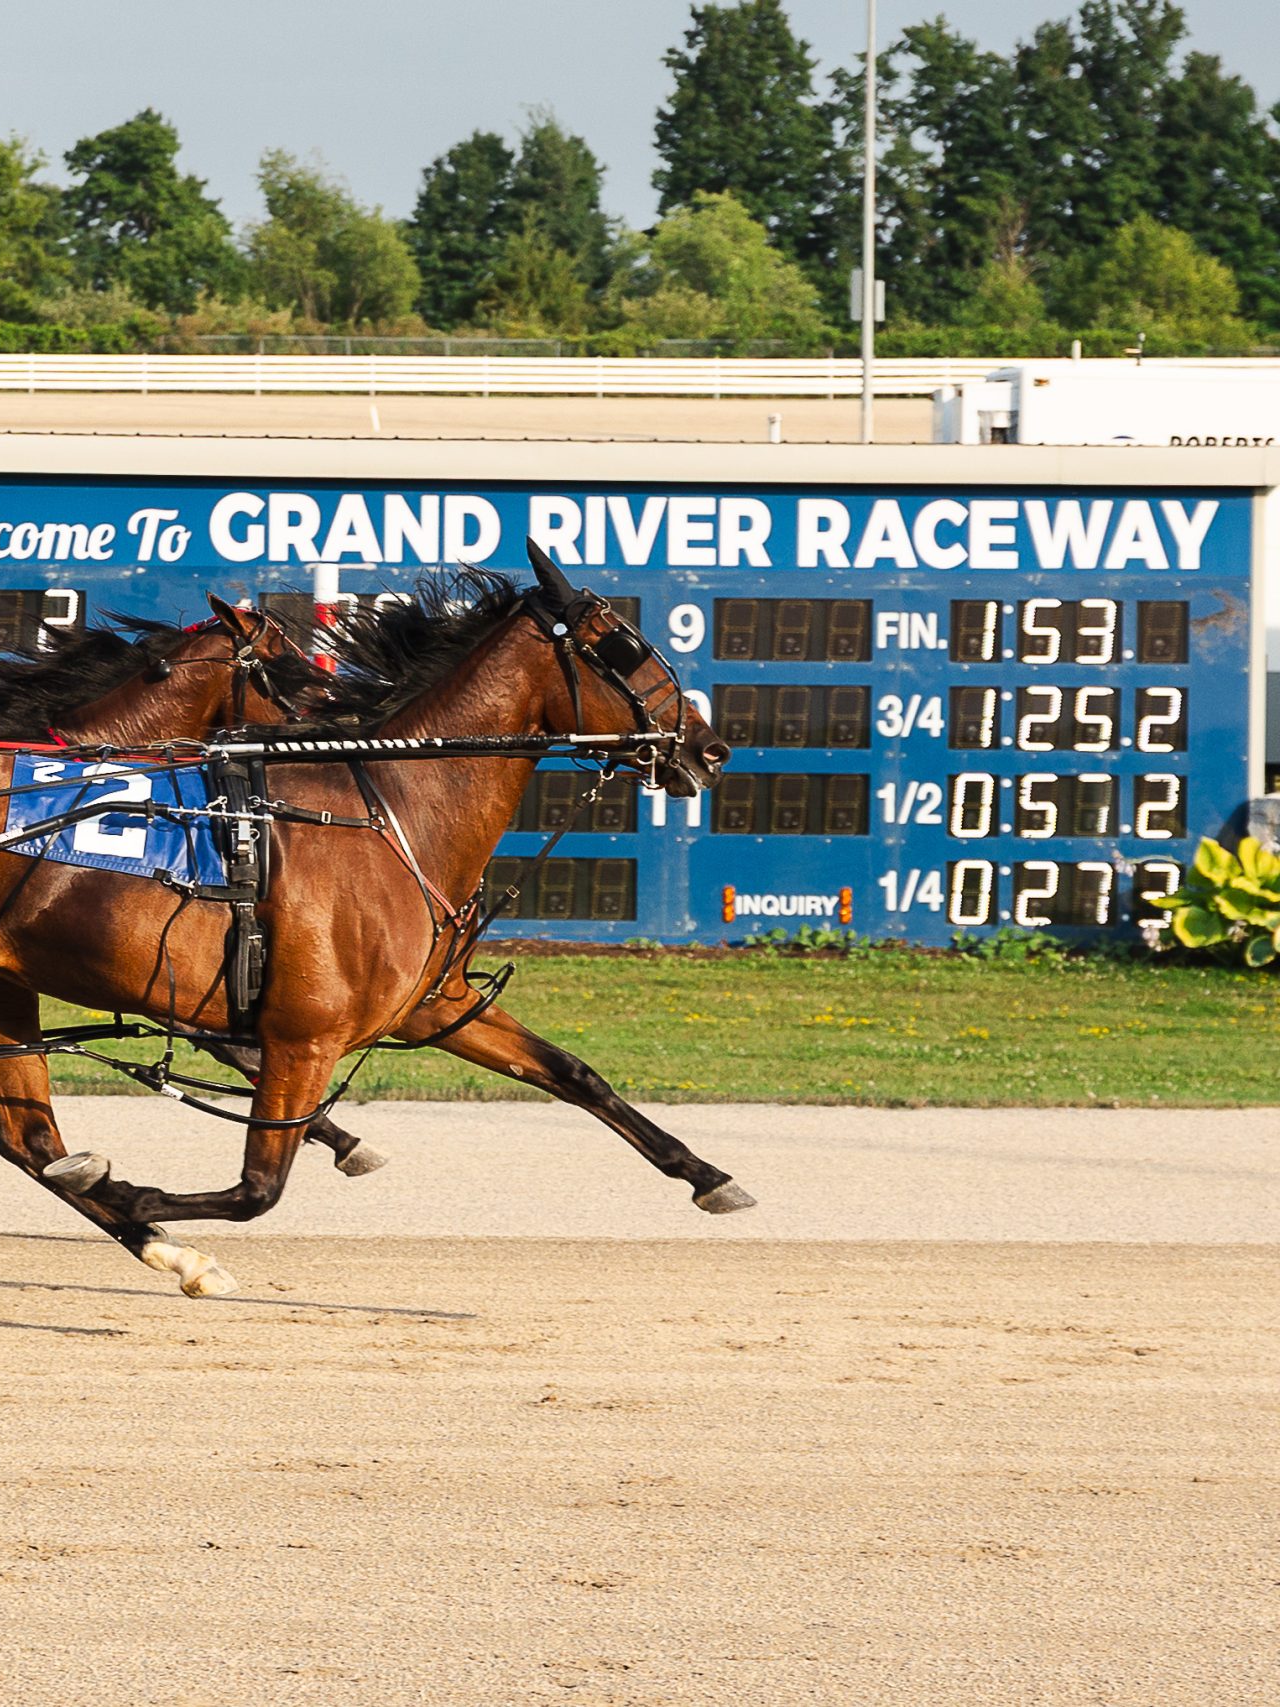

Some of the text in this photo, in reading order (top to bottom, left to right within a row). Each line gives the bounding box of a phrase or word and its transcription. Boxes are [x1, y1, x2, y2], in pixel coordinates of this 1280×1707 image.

[127, 508, 192, 562] To
[209, 492, 501, 564] GRAND
[528, 495, 772, 566] RIVER
[797, 498, 1220, 569] RACEWAY
[668, 603, 705, 653] 9
[876, 611, 948, 650] FIN.
[876, 694, 945, 738] 3/4
[980, 685, 1182, 752] 1:25.2
[73, 762, 153, 859] 2
[877, 781, 942, 825] 1/2
[950, 772, 1180, 839] 0:57.2
[734, 894, 840, 916] INQUIRY
[878, 869, 945, 913] 1/4
